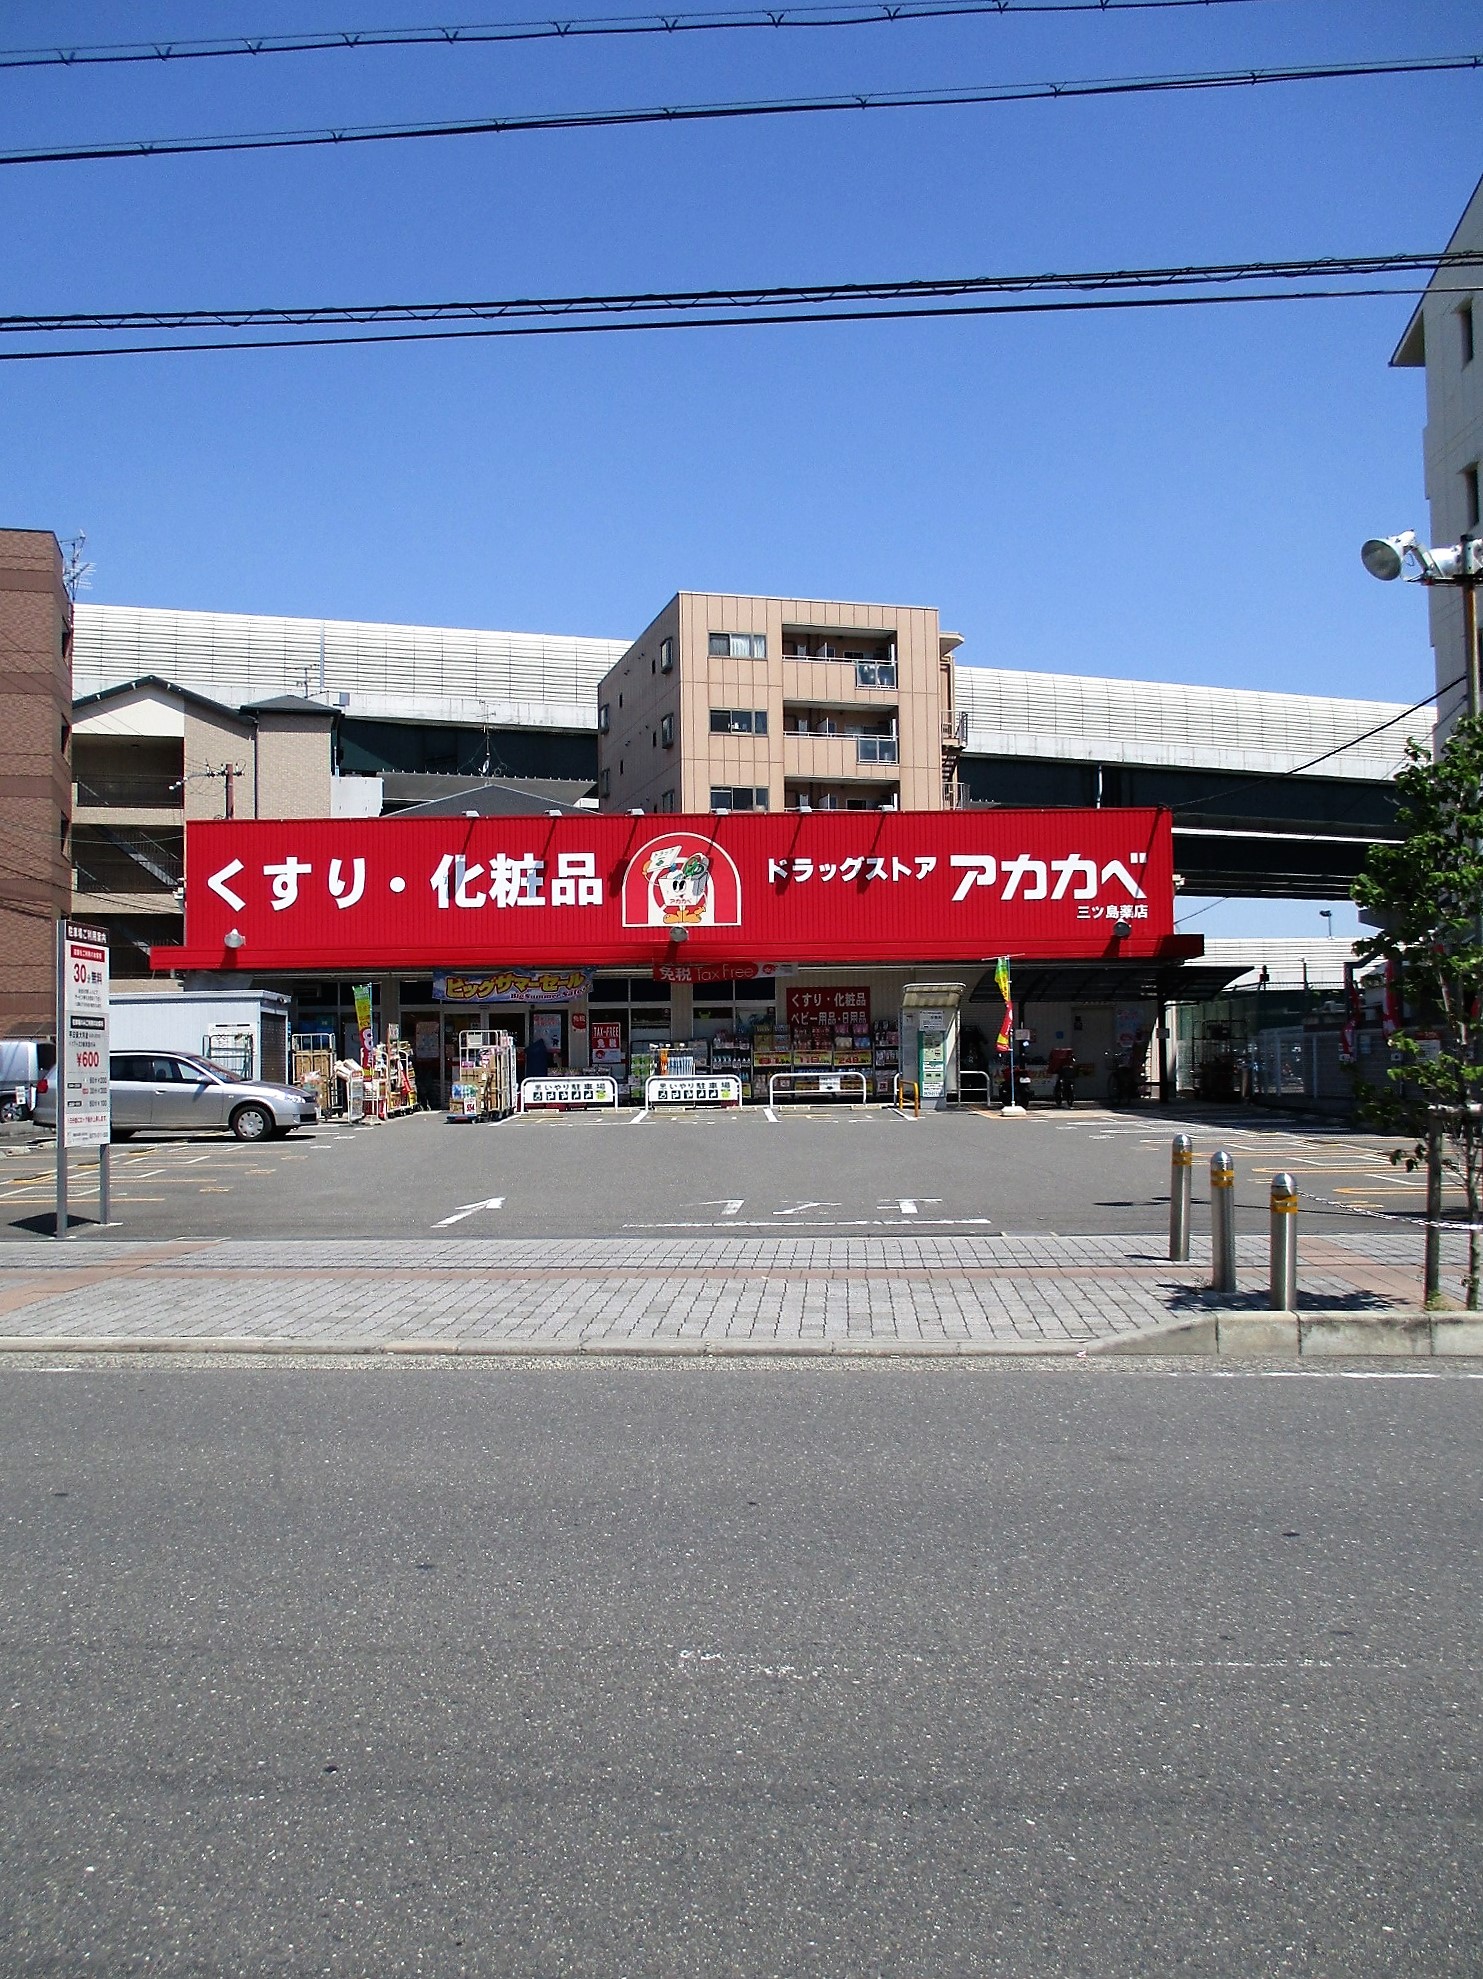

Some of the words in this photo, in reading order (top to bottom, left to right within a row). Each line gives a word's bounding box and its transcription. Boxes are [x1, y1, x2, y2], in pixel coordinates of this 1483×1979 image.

[767, 856, 937, 883] ドラッグストア
[950, 852, 1147, 901] アカカベ
[207, 852, 603, 912] くすり・化粧品
[1076, 904, 1149, 919] 三ツ島薬店
[659, 965, 692, 981] 免税
[695, 966, 720, 981] Tax
[722, 963, 754, 980] Free
[446, 972, 586, 999] ビッグサマーセール
[791, 992, 867, 1007] くすり・化粧品
[791, 1011, 867, 1026] ベビー用品・日用品
[593, 1026, 619, 1037] TAX-FREE
[77, 1051, 99, 1067] ¥600
